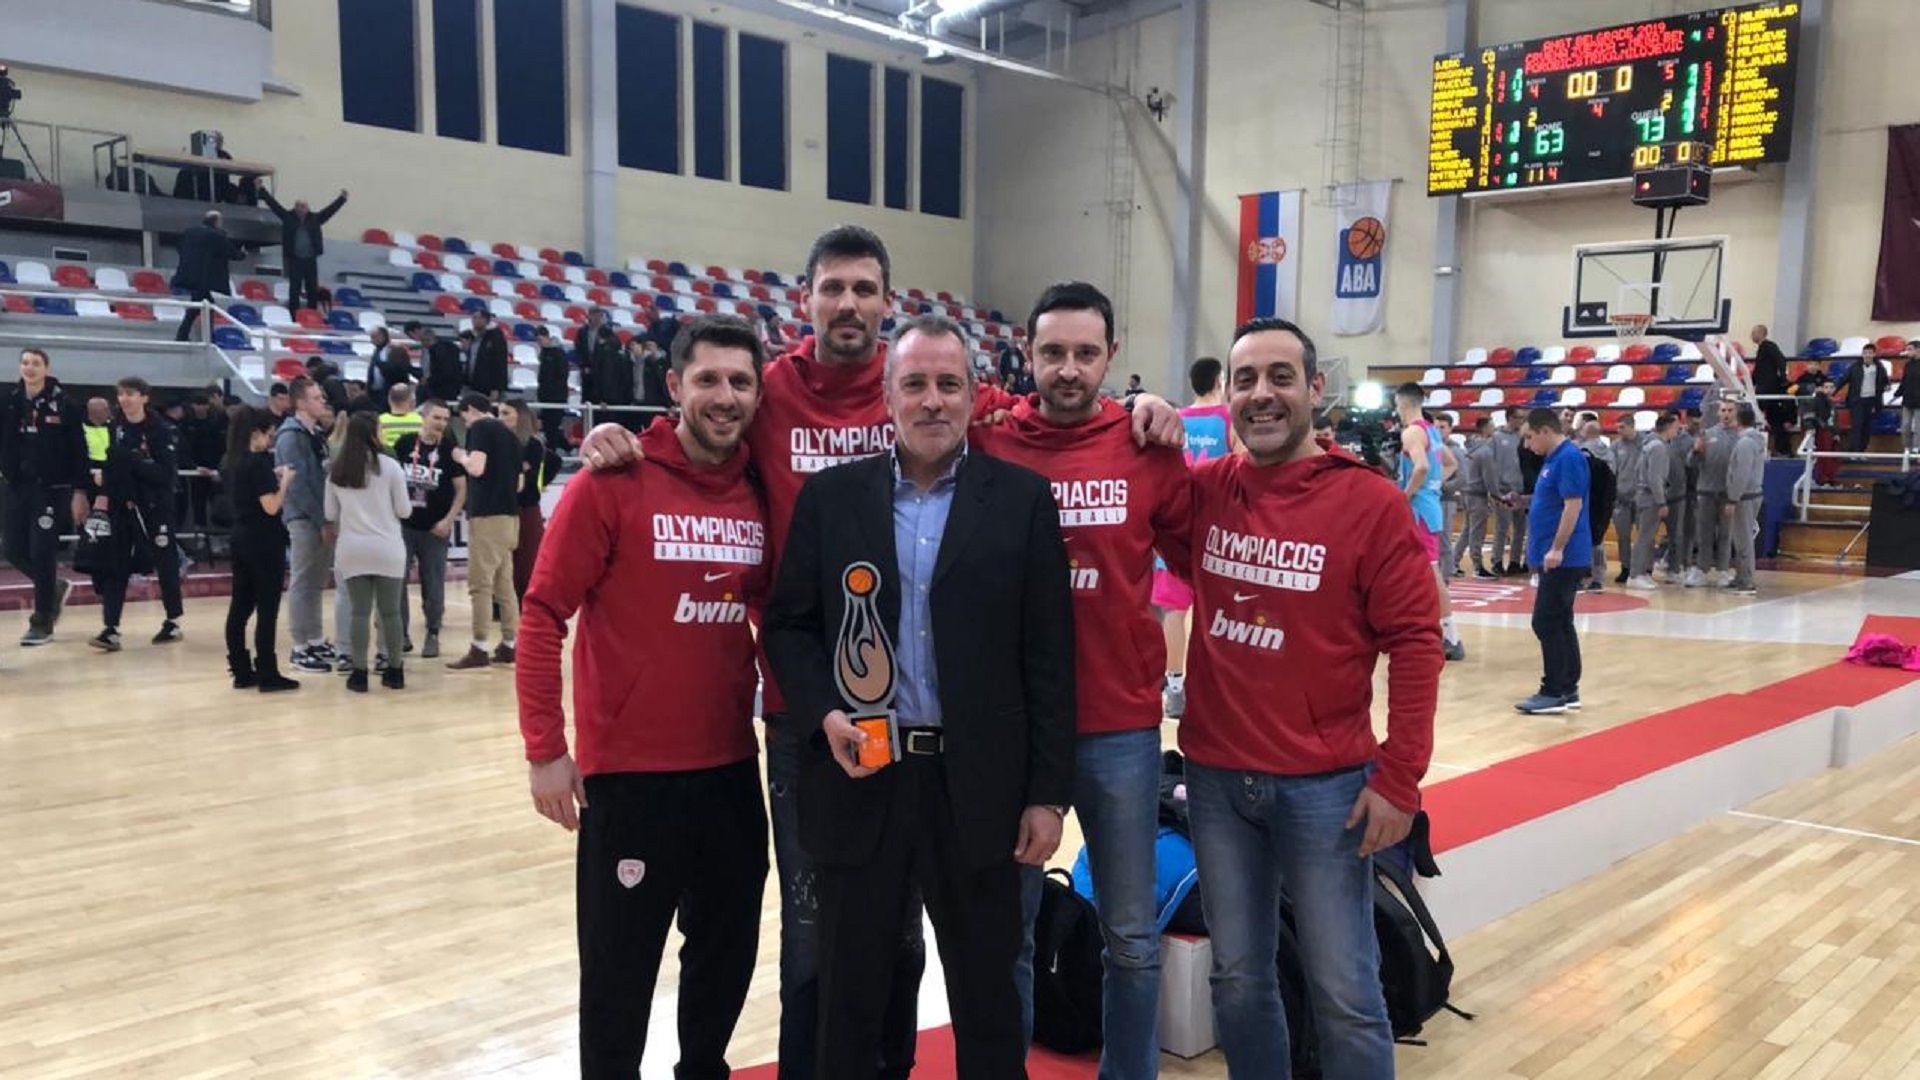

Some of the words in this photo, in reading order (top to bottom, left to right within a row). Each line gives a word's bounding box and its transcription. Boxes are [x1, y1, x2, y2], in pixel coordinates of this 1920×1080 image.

[1535, 121, 1562, 132] HOME
[1536, 129, 1564, 154] 63
[1636, 117, 1665, 142] 73
[1341, 263, 1377, 293] ABA
[653, 513, 765, 547] OLYMPIACOS
[658, 544, 761, 562] BASKETBALL
[1205, 524, 1327, 572] OLYMPIACOS
[1203, 554, 1317, 590] BASKETBALL
[673, 592, 748, 623] bwin
[1209, 608, 1285, 650] bwin
